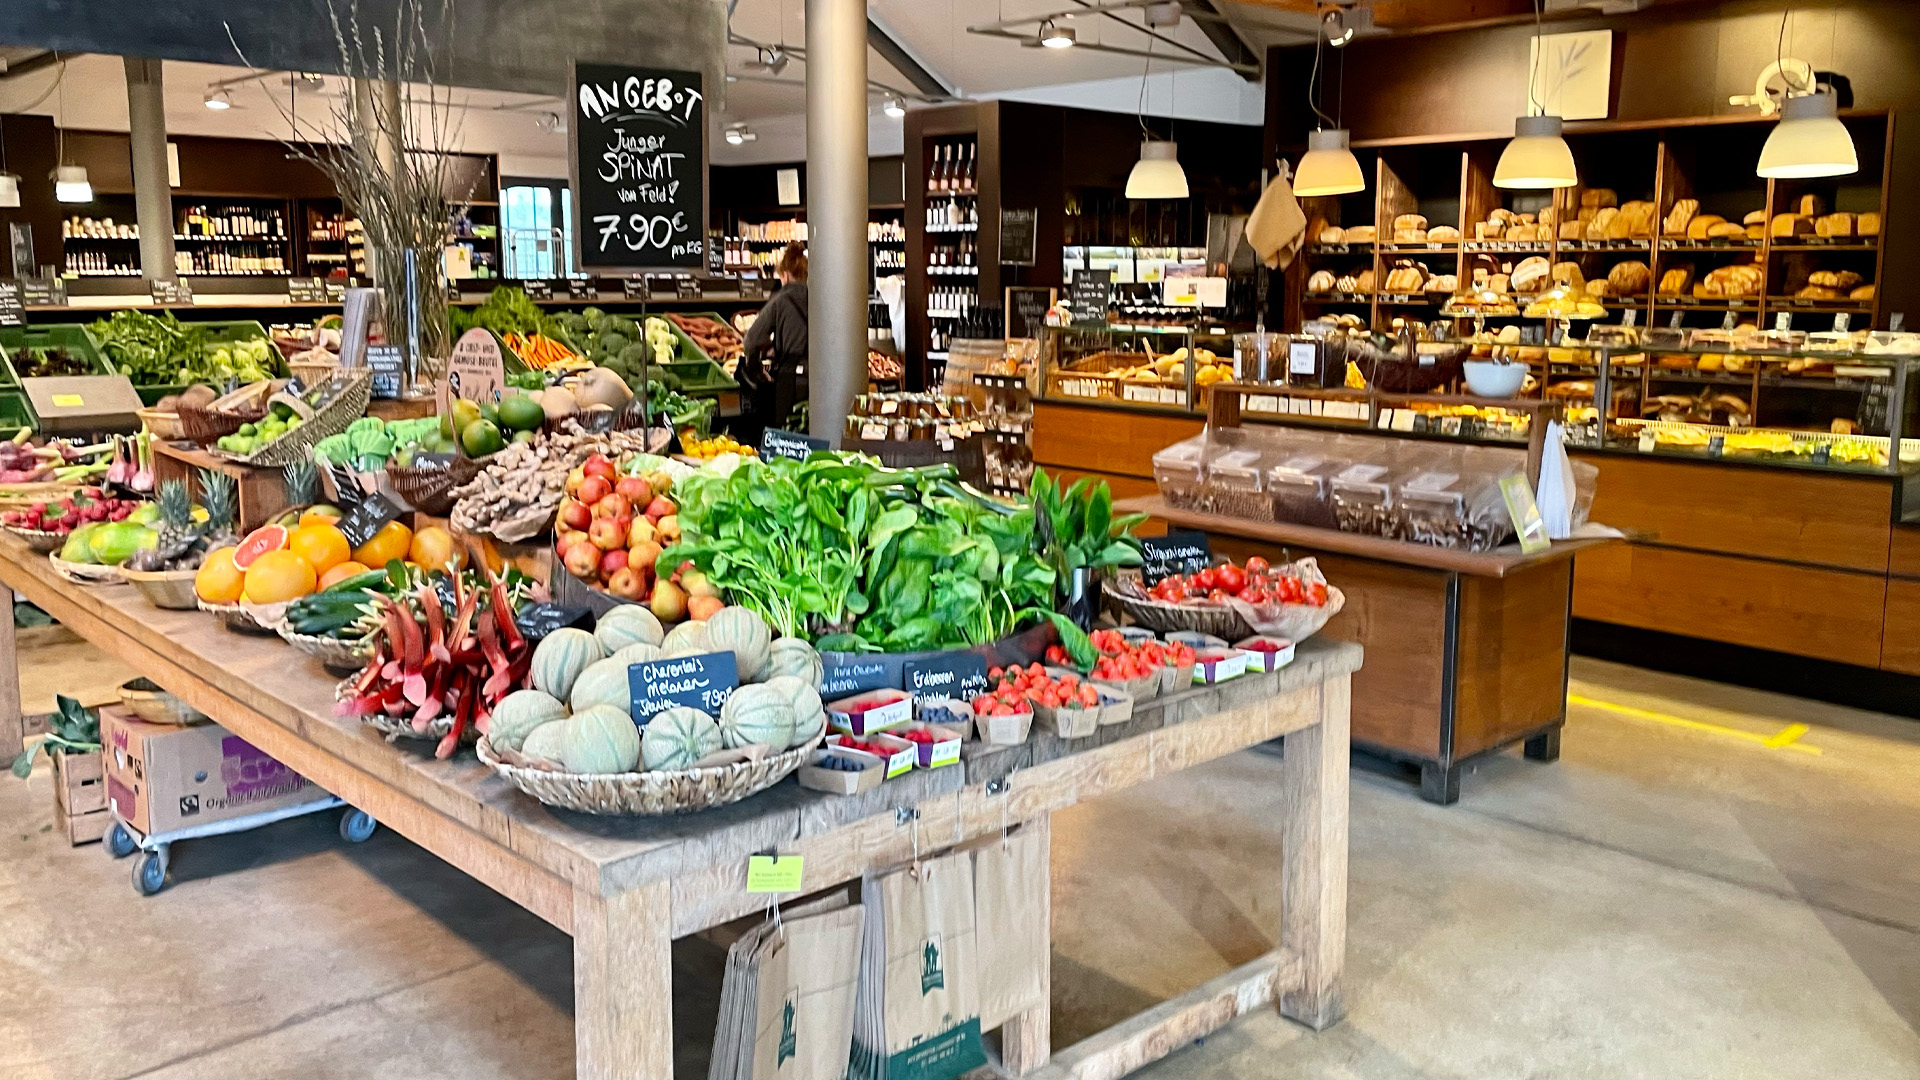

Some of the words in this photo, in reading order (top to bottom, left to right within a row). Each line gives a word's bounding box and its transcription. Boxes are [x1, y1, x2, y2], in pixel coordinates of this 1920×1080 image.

[579, 75, 703, 121] ANGEBOT
[606, 128, 666, 155] Junger
[637, 179, 680, 204] Feld!
